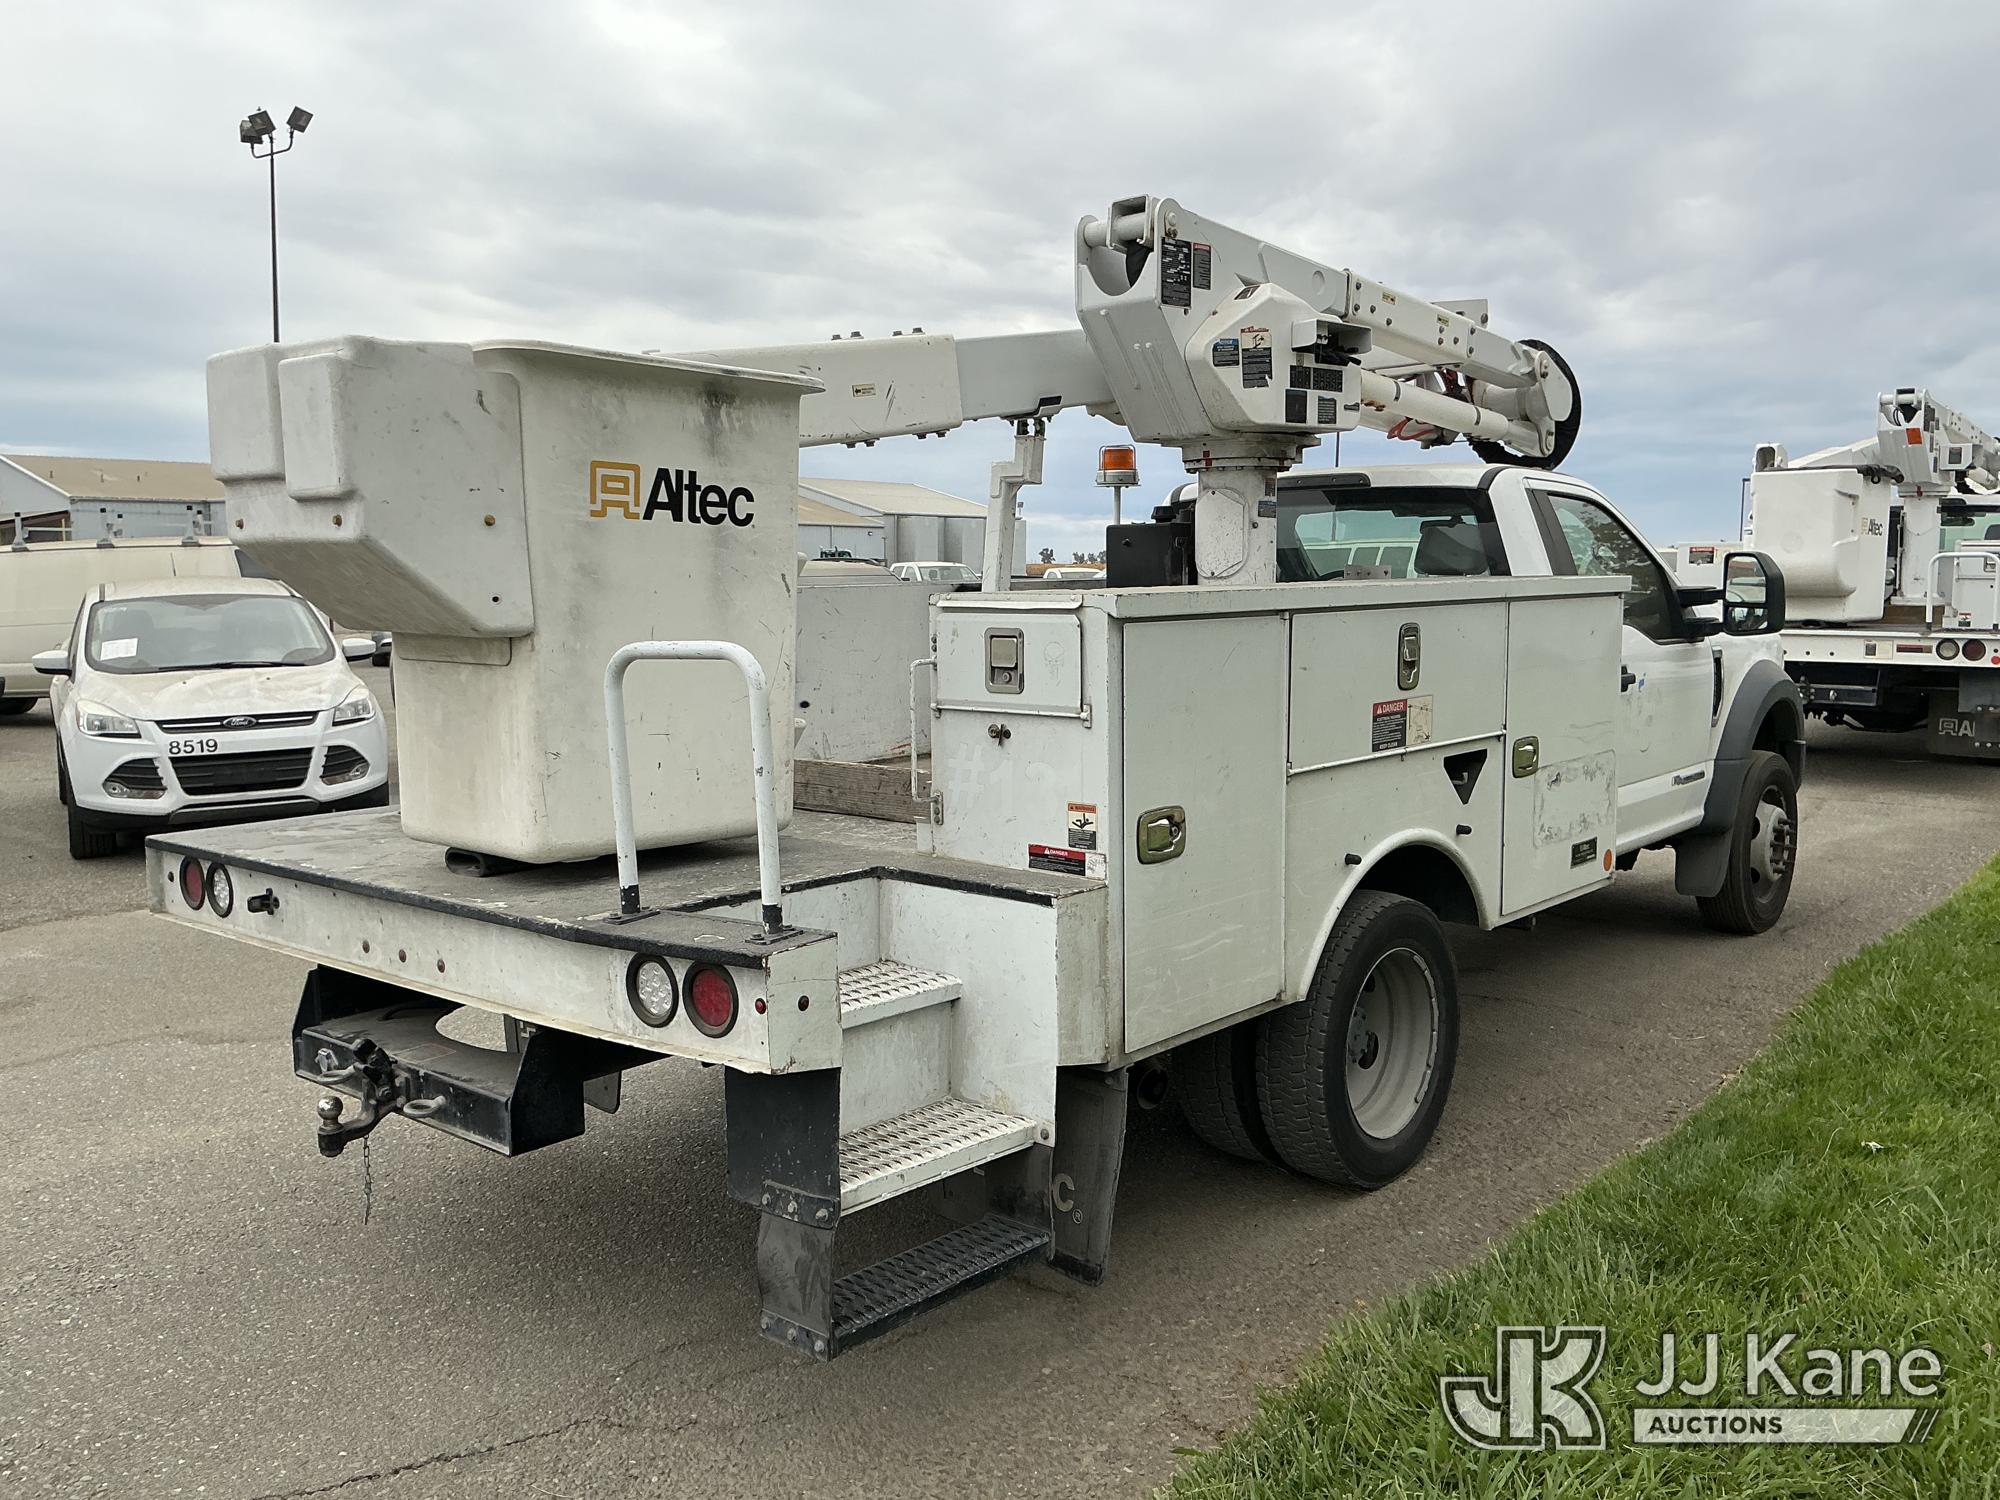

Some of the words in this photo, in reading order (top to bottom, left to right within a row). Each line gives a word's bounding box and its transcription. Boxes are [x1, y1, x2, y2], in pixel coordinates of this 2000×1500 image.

[642, 467, 755, 527] Altec
[1868, 518, 1883, 536] Altec
[1382, 702, 1403, 713] DANGER
[168, 738, 219, 755] 8519
